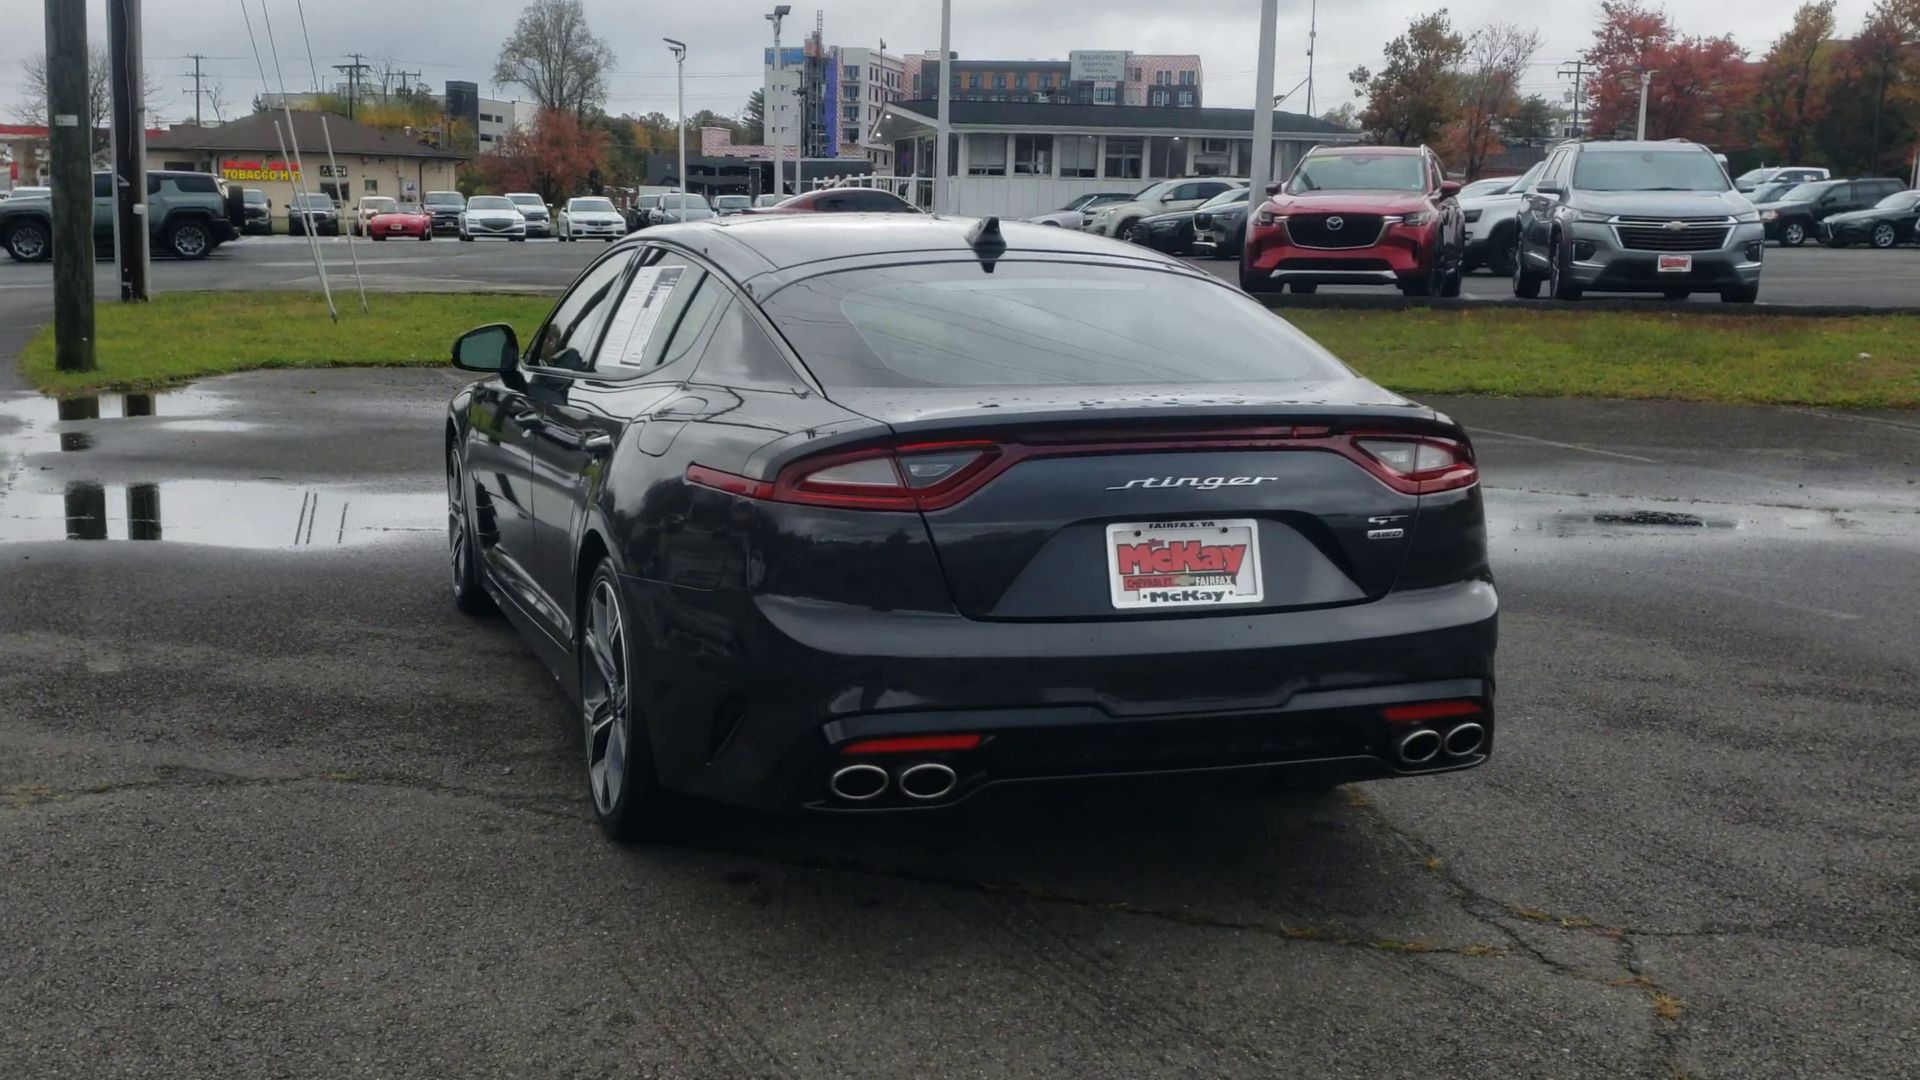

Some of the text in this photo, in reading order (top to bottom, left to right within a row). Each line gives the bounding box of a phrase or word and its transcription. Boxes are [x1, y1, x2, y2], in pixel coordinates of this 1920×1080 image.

[223, 169, 277, 180] TOBACCO
[1116, 540, 1248, 575] McKay
[1195, 575, 1232, 587] FAIRFAX
[1149, 590, 1226, 603] McKay
